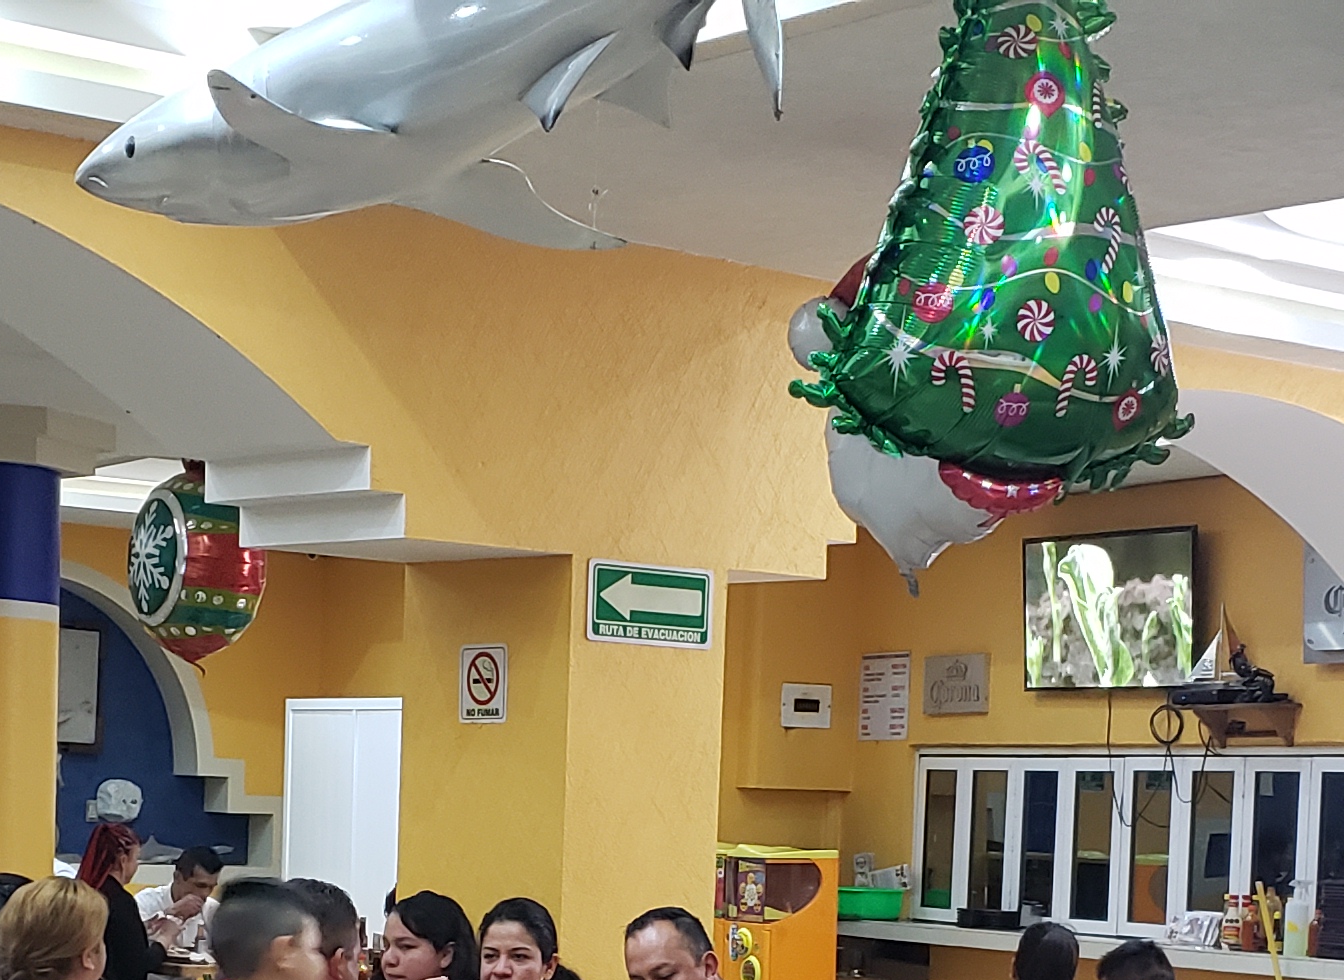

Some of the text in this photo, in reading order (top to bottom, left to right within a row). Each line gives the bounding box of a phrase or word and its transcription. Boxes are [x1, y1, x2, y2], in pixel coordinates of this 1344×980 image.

[599, 624, 701, 642] RUTA DE EVACUACION
[930, 680, 980, 709] Corona
[466, 708, 500, 717] NO FUMAR
